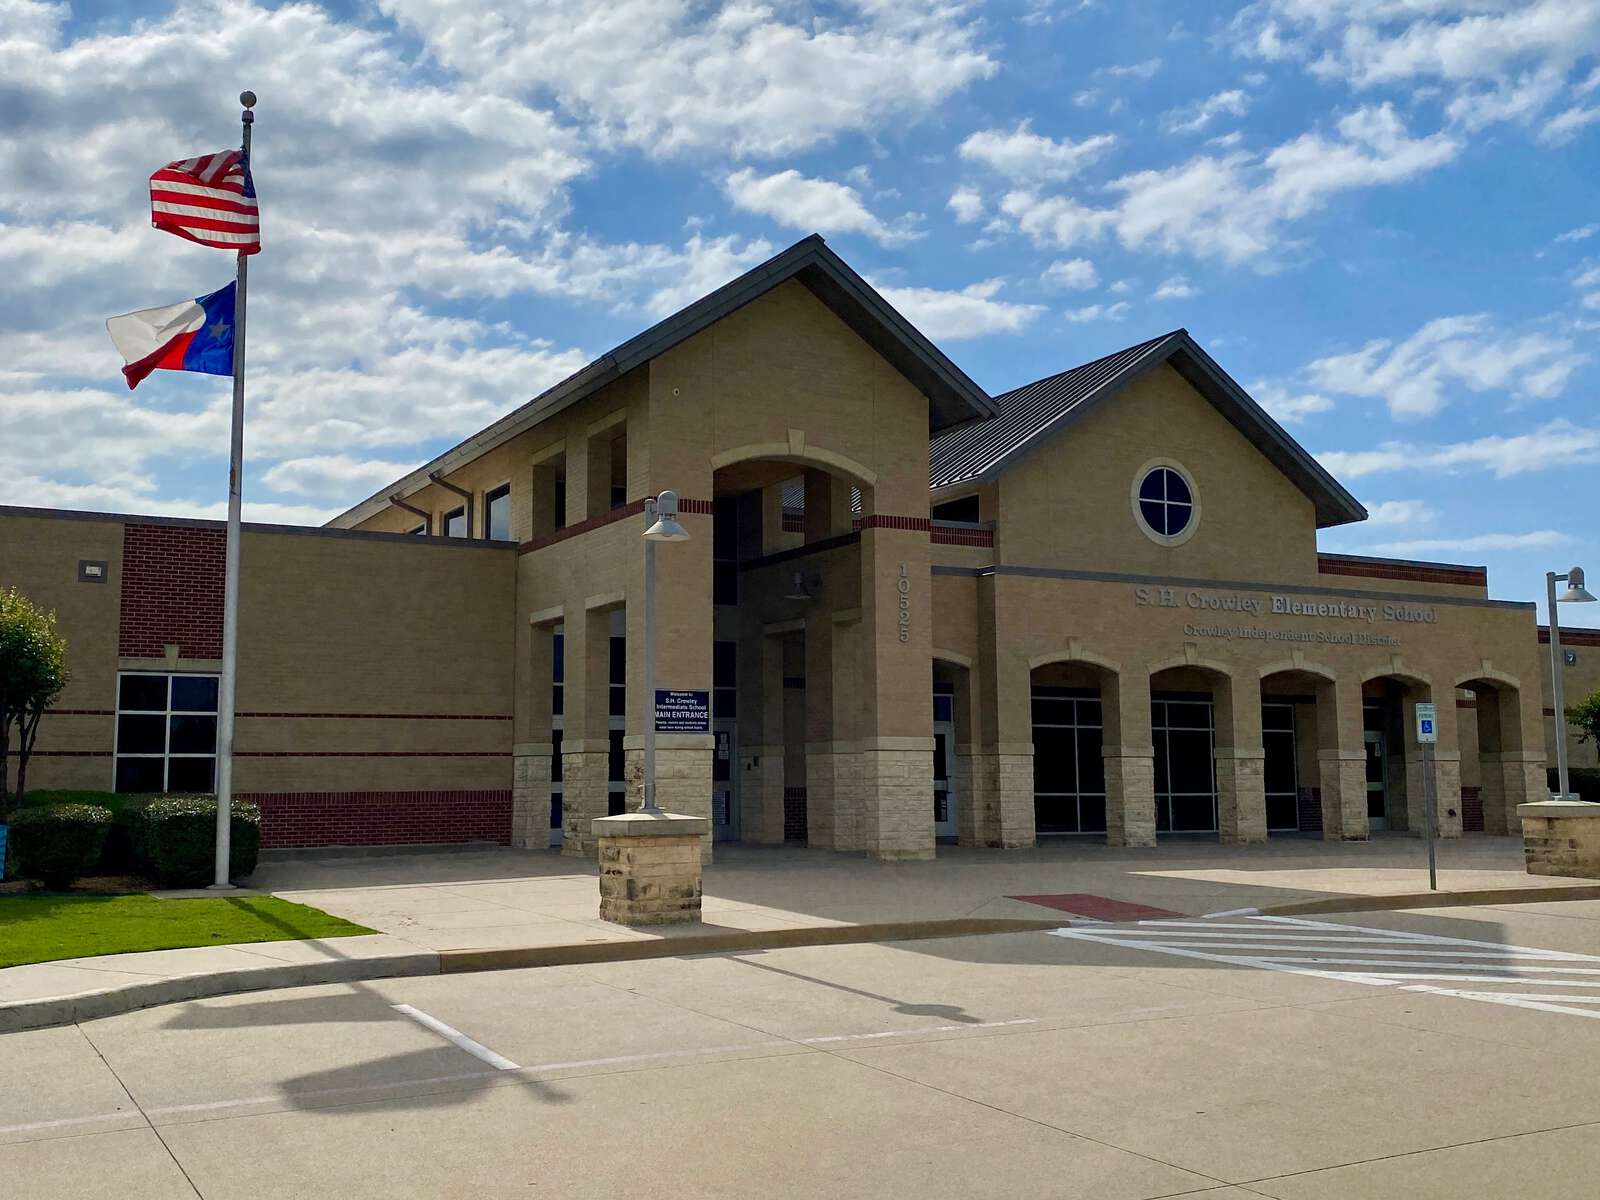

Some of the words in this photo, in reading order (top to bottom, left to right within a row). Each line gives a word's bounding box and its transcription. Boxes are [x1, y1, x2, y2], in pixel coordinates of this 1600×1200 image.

[898, 562, 911, 642] 10525
[1185, 591, 1262, 617] Crowley
[1271, 594, 1377, 624] Elementary
[1383, 603, 1440, 624] School
[1183, 622, 1234, 641] Crowley
[1238, 626, 1312, 644] Independent
[1316, 631, 1353, 646] School
[672, 711, 709, 719] ENTRANCE
